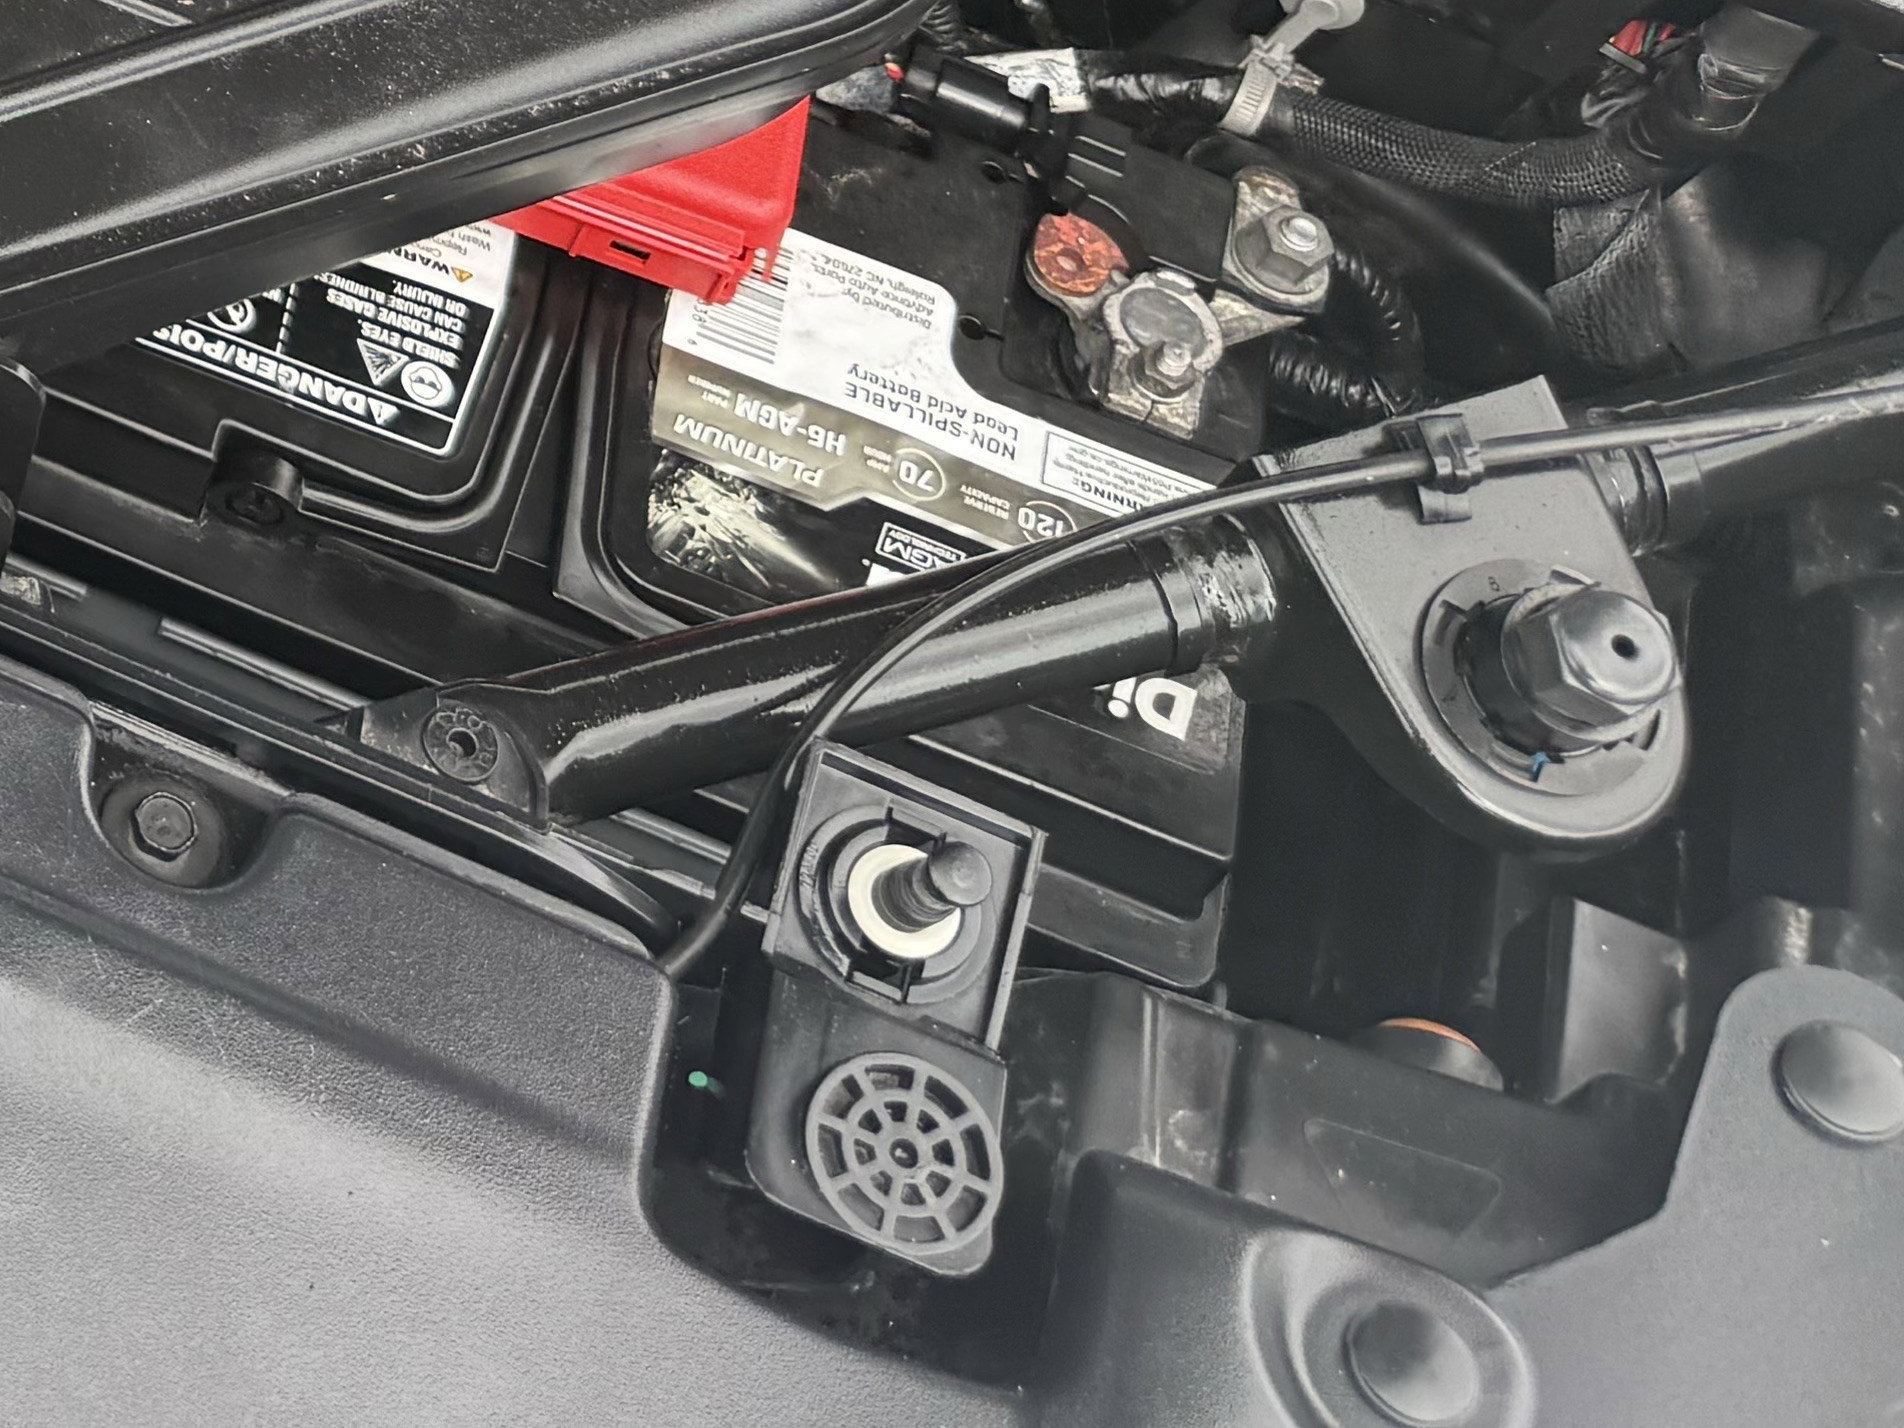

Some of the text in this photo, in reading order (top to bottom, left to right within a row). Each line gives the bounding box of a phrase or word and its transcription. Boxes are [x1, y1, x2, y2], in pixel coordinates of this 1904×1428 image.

[848, 275, 882, 298] Auto
[865, 270, 886, 286] NC
[326, 289, 380, 318] GASES
[387, 294, 433, 323] CAUSE
[392, 278, 470, 317] OR INJURY.
[863, 296, 933, 330] Distributed
[377, 311, 465, 351] EXPLOSIVE
[429, 310, 466, 332] CAN
[357, 319, 462, 370] SHIELD EYES.
[847, 362, 1020, 441] Lead Acid Battery
[701, 390, 847, 456] H6-AGM PART
[844, 381, 1017, 461] NON-SPILLABLE
[673, 413, 826, 488] PLATINUM
[898, 458, 935, 492] 70
[959, 483, 1011, 512] CAPACITY
[963, 496, 1010, 521] RESERVE
[1097, 678, 1200, 743] Di
